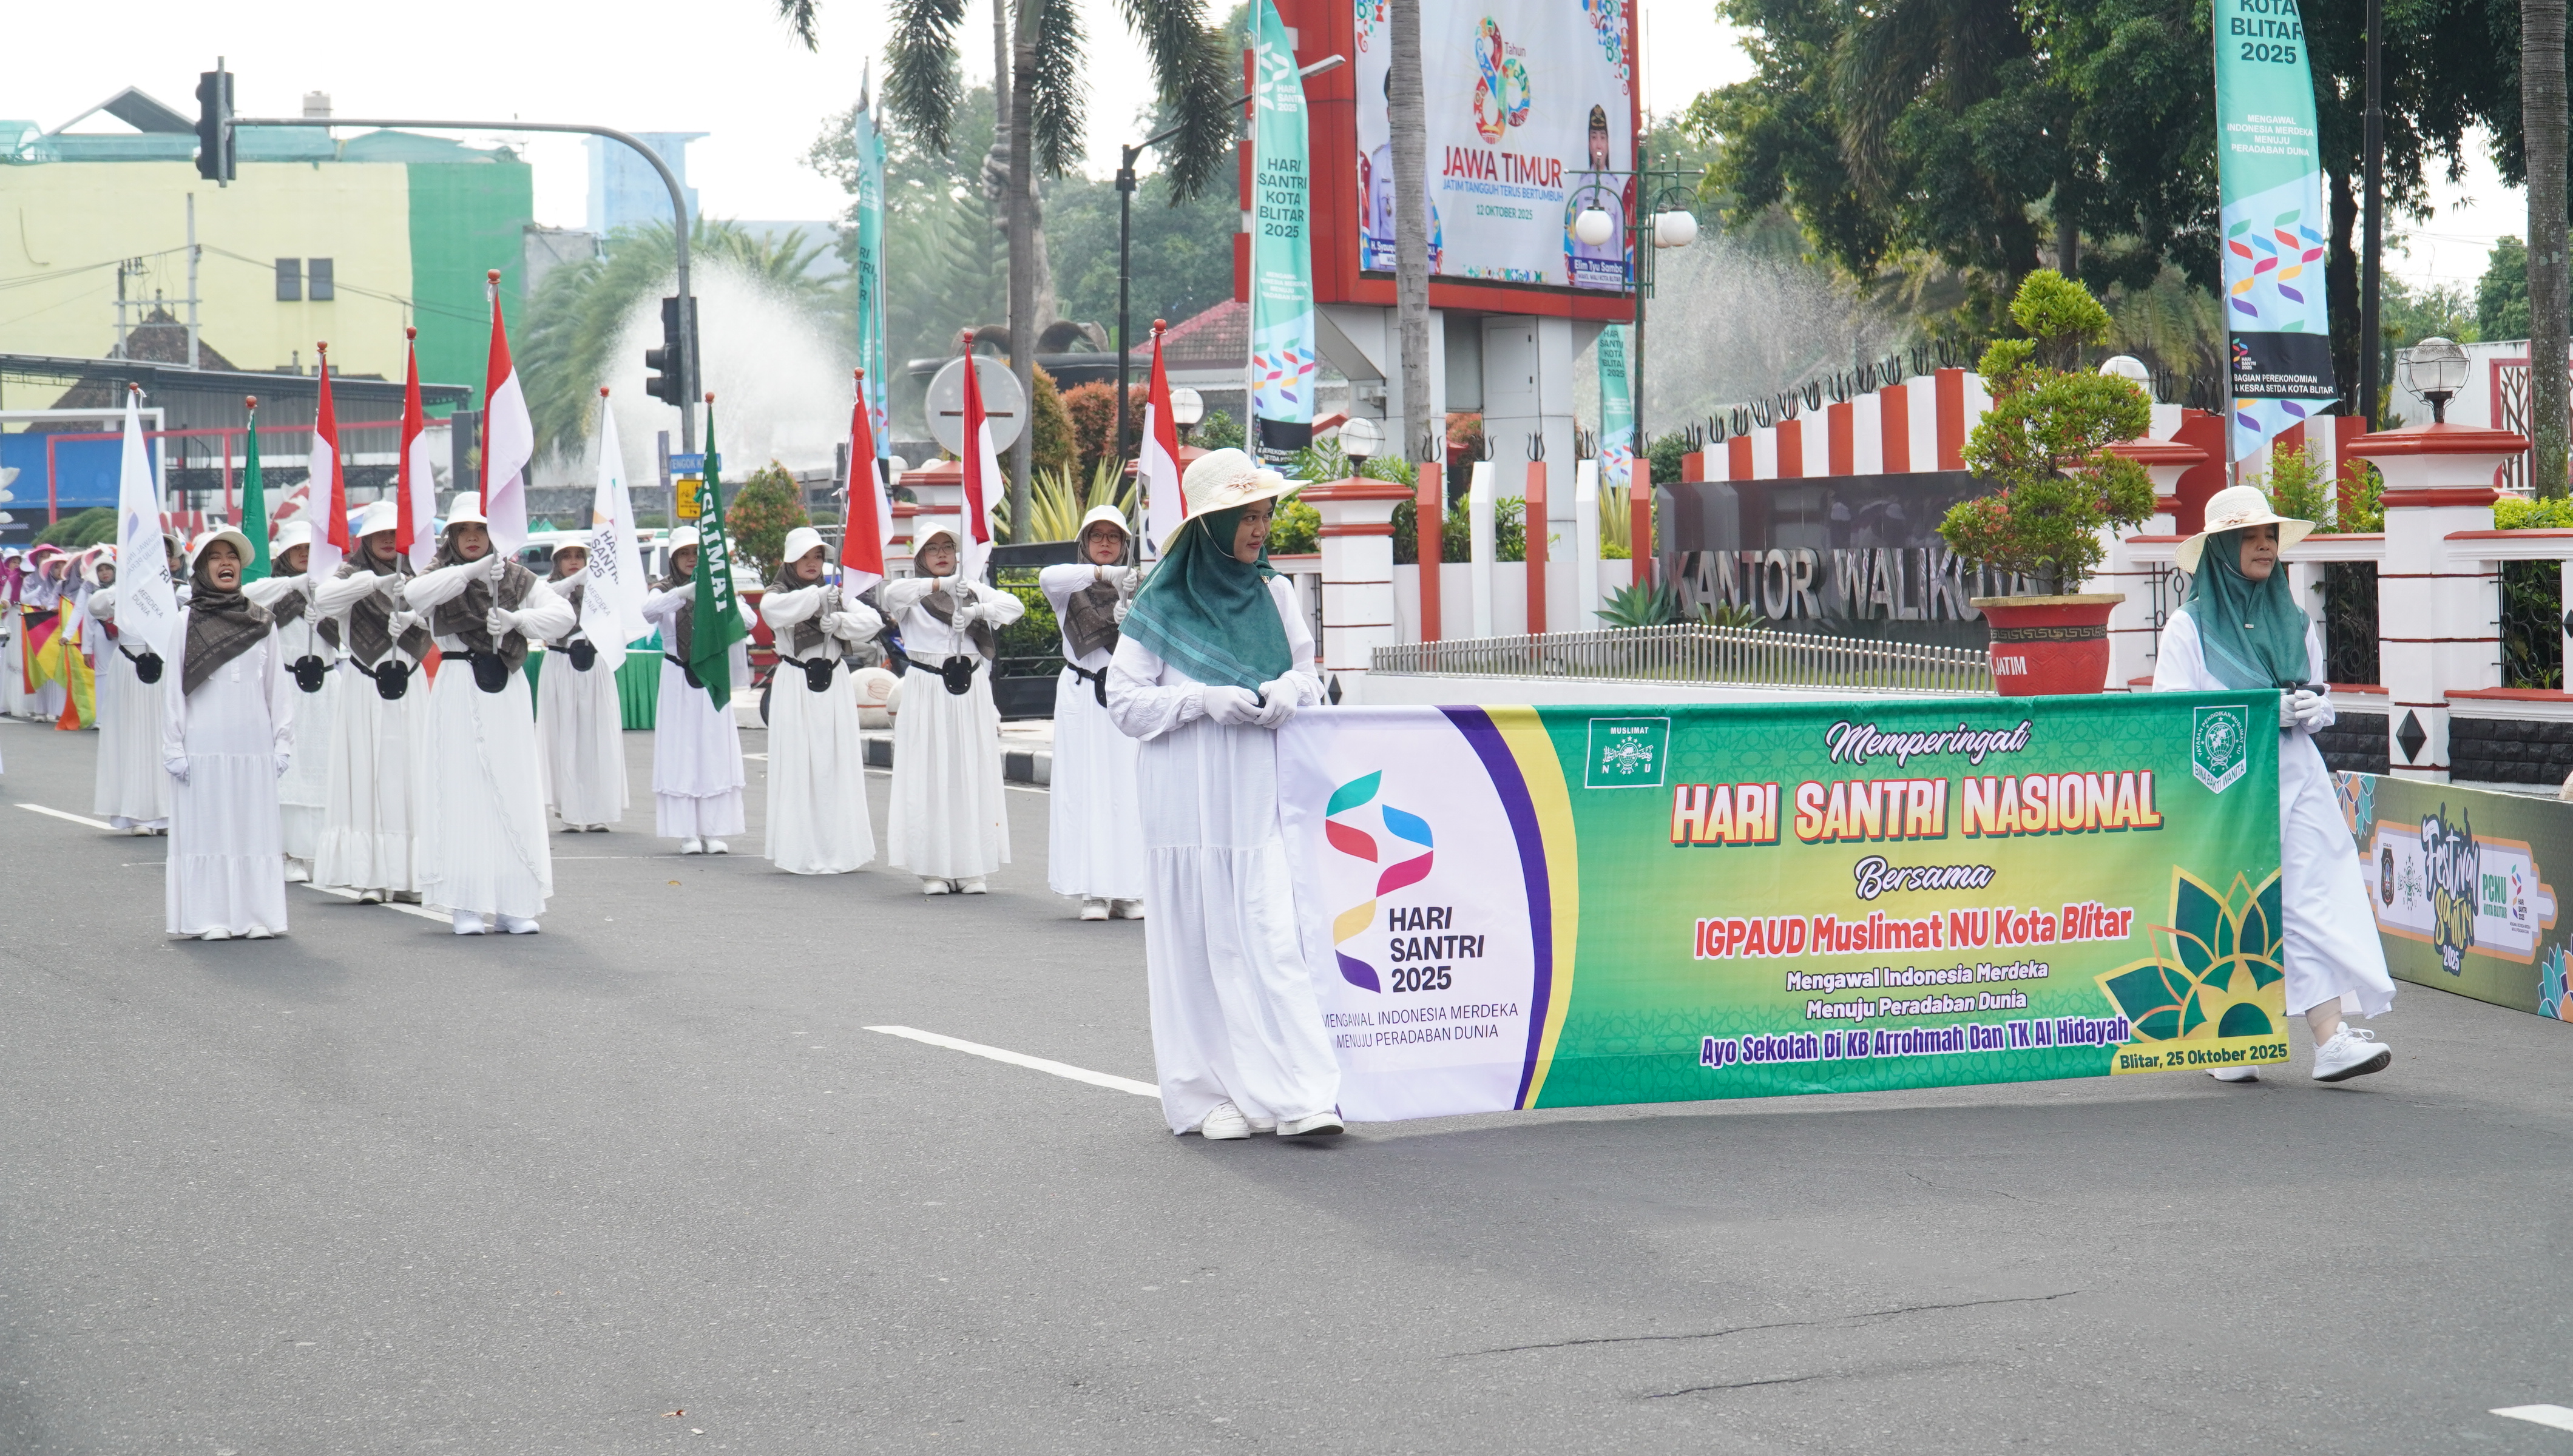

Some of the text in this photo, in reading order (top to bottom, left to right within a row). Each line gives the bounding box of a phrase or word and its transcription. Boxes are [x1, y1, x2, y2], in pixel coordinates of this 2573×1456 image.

[2240, 0, 2297, 15] KOTA
[2231, 17, 2304, 41] BLITAR
[1504, 42, 1526, 57] Tahun
[2241, 42, 2296, 64] 2025
[1277, 84, 1296, 93] HARI
[1277, 103, 1297, 112] 2025
[2227, 123, 2314, 136] INDONESIA MERDEKA
[2248, 115, 2296, 124] MENGAWAL
[2231, 144, 2310, 157] PERADABAN DUNIA
[2254, 135, 2290, 144] MENUJU
[1268, 158, 1300, 172] HARI
[1443, 146, 1563, 188] JAWA TIMUR
[1259, 174, 1307, 189] SANTRI
[1443, 178, 1564, 202] JATIM TANGGUH TERUS BERTUMBUH
[1266, 190, 1300, 205] KOTA
[1260, 206, 1304, 221] BLITAR
[1476, 204, 1533, 220] 12 OKTOBER 2025
[1265, 223, 1299, 238] 2025
[1574, 259, 1588, 270] Elim
[1588, 260, 1600, 272] Tyu
[1607, 369, 1625, 377] 2025
[2262, 374, 2318, 383] PEREKONOMIAN
[2288, 385, 2308, 393] KOTA
[2310, 385, 2334, 394] BLITAR
[1669, 548, 1821, 621] KANTOR
[132, 594, 150, 617] DUNIA
[1995, 656, 2027, 676] JATIM
[1825, 720, 2033, 768] Memperingati
[2196, 711, 2243, 757] YAYASAN PENDIDIKAN MUSLIMAT NU
[1602, 764, 1651, 774] N U
[2195, 763, 2245, 791] BINA BAKTI WANITA
[1671, 770, 2163, 846] HARI SANTRI NASIONAL
[2423, 817, 2479, 906] Festival
[1854, 855, 1995, 900] Bersama
[2483, 874, 2507, 905] PCNU
[1389, 906, 1452, 932] HARI
[2483, 903, 2507, 918] KOTA BLITAR
[1694, 900, 2134, 960] IGPAUD Muslimat NU Kota Blitar
[1390, 935, 1484, 963] SANTRI
[2443, 945, 2460, 971] 2025
[1391, 966, 1452, 993] 2025
[1786, 960, 2049, 993] Mengawal Indonesia Merdeka
[1322, 1003, 1518, 1028] MENGAWAL INDONESIA MERDEKA
[1806, 989, 2027, 1022] Menuju Peradaban Dunia
[1337, 1025, 1498, 1048] MENUJU PERADABAN DUNIA
[1700, 1036, 1738, 1069] Ayo
[1740, 1033, 1819, 1064] Sekolah
[1822, 1030, 1843, 1060] Di
[1845, 1029, 1870, 1059] KB
[1873, 1023, 1966, 1057] Arrohmah
[1968, 1021, 2006, 1052] Dan
[2007, 1019, 2030, 1050] TK
[2058, 1014, 2131, 1048] Hidayah
[2120, 1043, 2288, 1071] Blitar, 25 Oktober 2025
